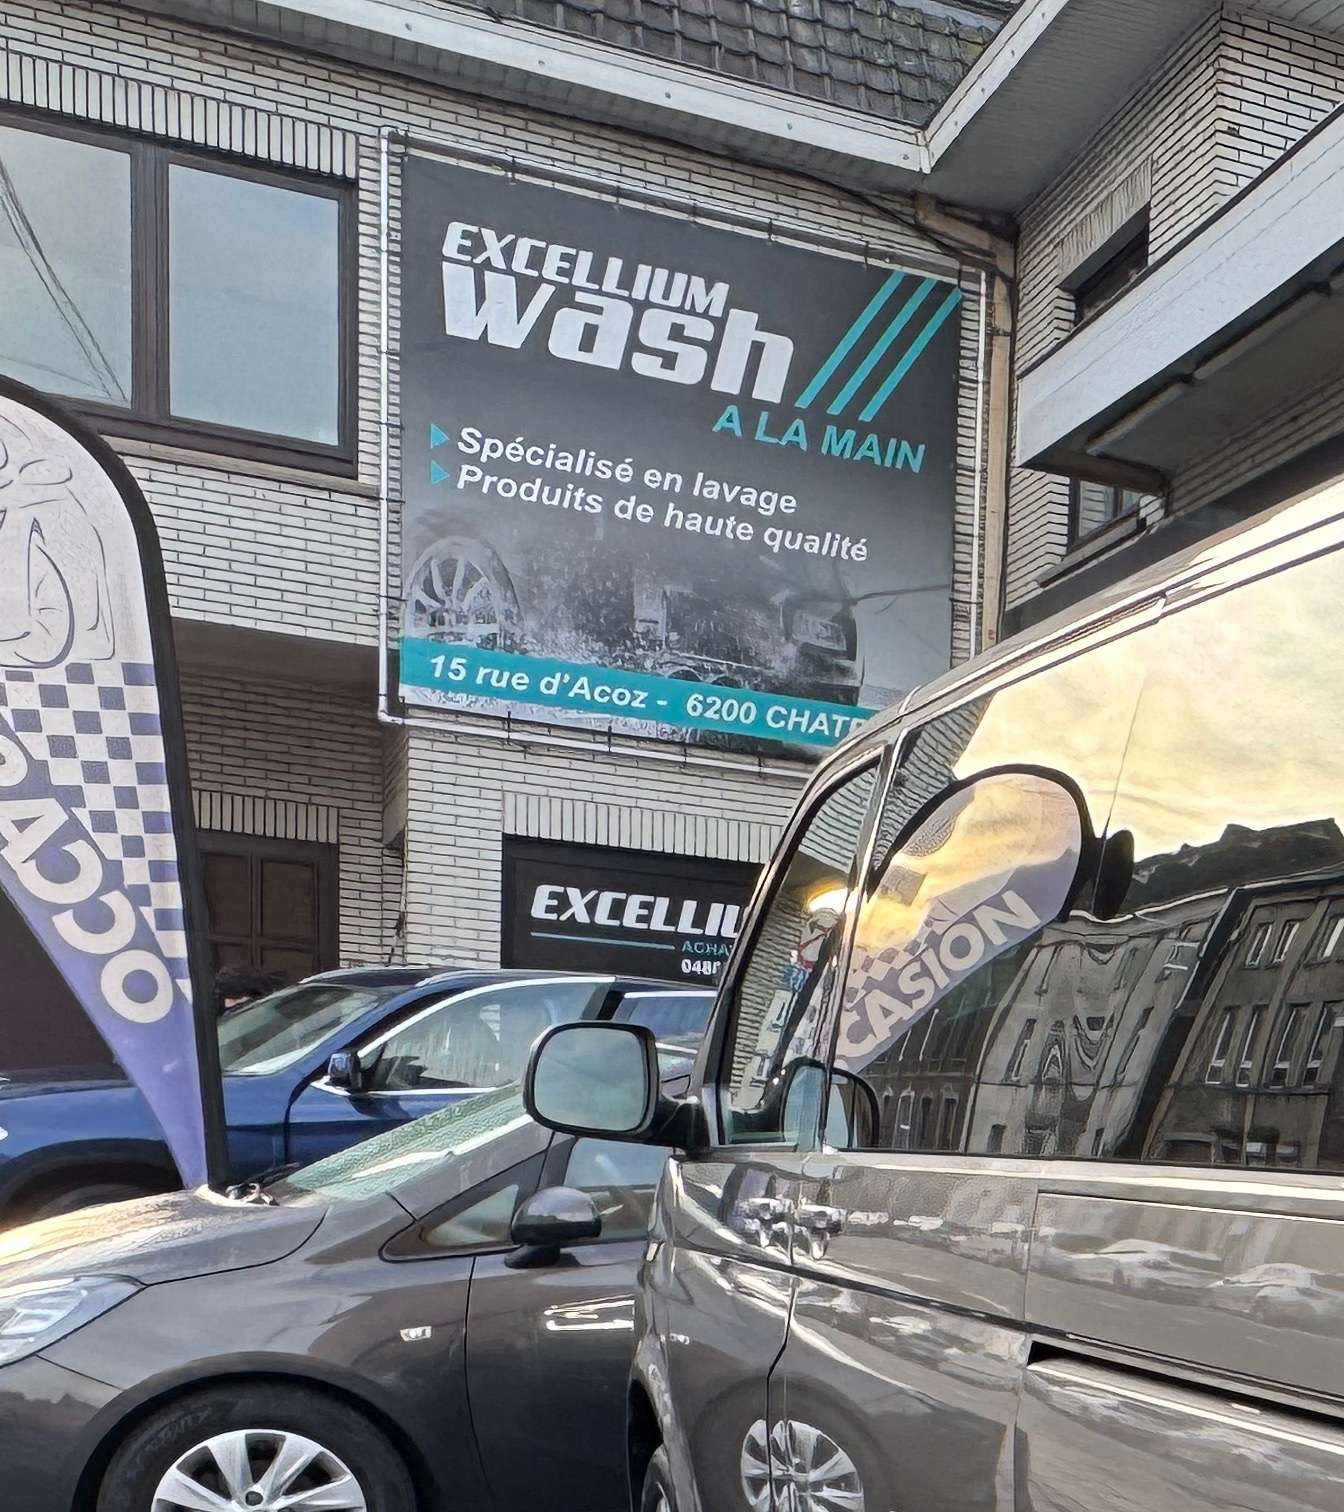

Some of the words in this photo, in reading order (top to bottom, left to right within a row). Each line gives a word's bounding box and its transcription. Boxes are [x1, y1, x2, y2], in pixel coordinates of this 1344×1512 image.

[442, 221, 730, 318] EXCELLIUM
[457, 427, 633, 484] Spécialisé
[643, 467, 683, 493] en
[693, 472, 798, 517] lavage
[712, 404, 743, 438] A
[755, 411, 807, 451] LA
[820, 424, 926, 474] MAIN
[456, 464, 603, 514] Produits
[614, 494, 655, 523] de
[664, 502, 755, 542] haute
[763, 524, 869, 563] qualité
[430, 655, 467, 681] 15
[475, 666, 530, 690] rue
[686, 692, 757, 725] 6200
[681, 940, 733, 957] ACHA
